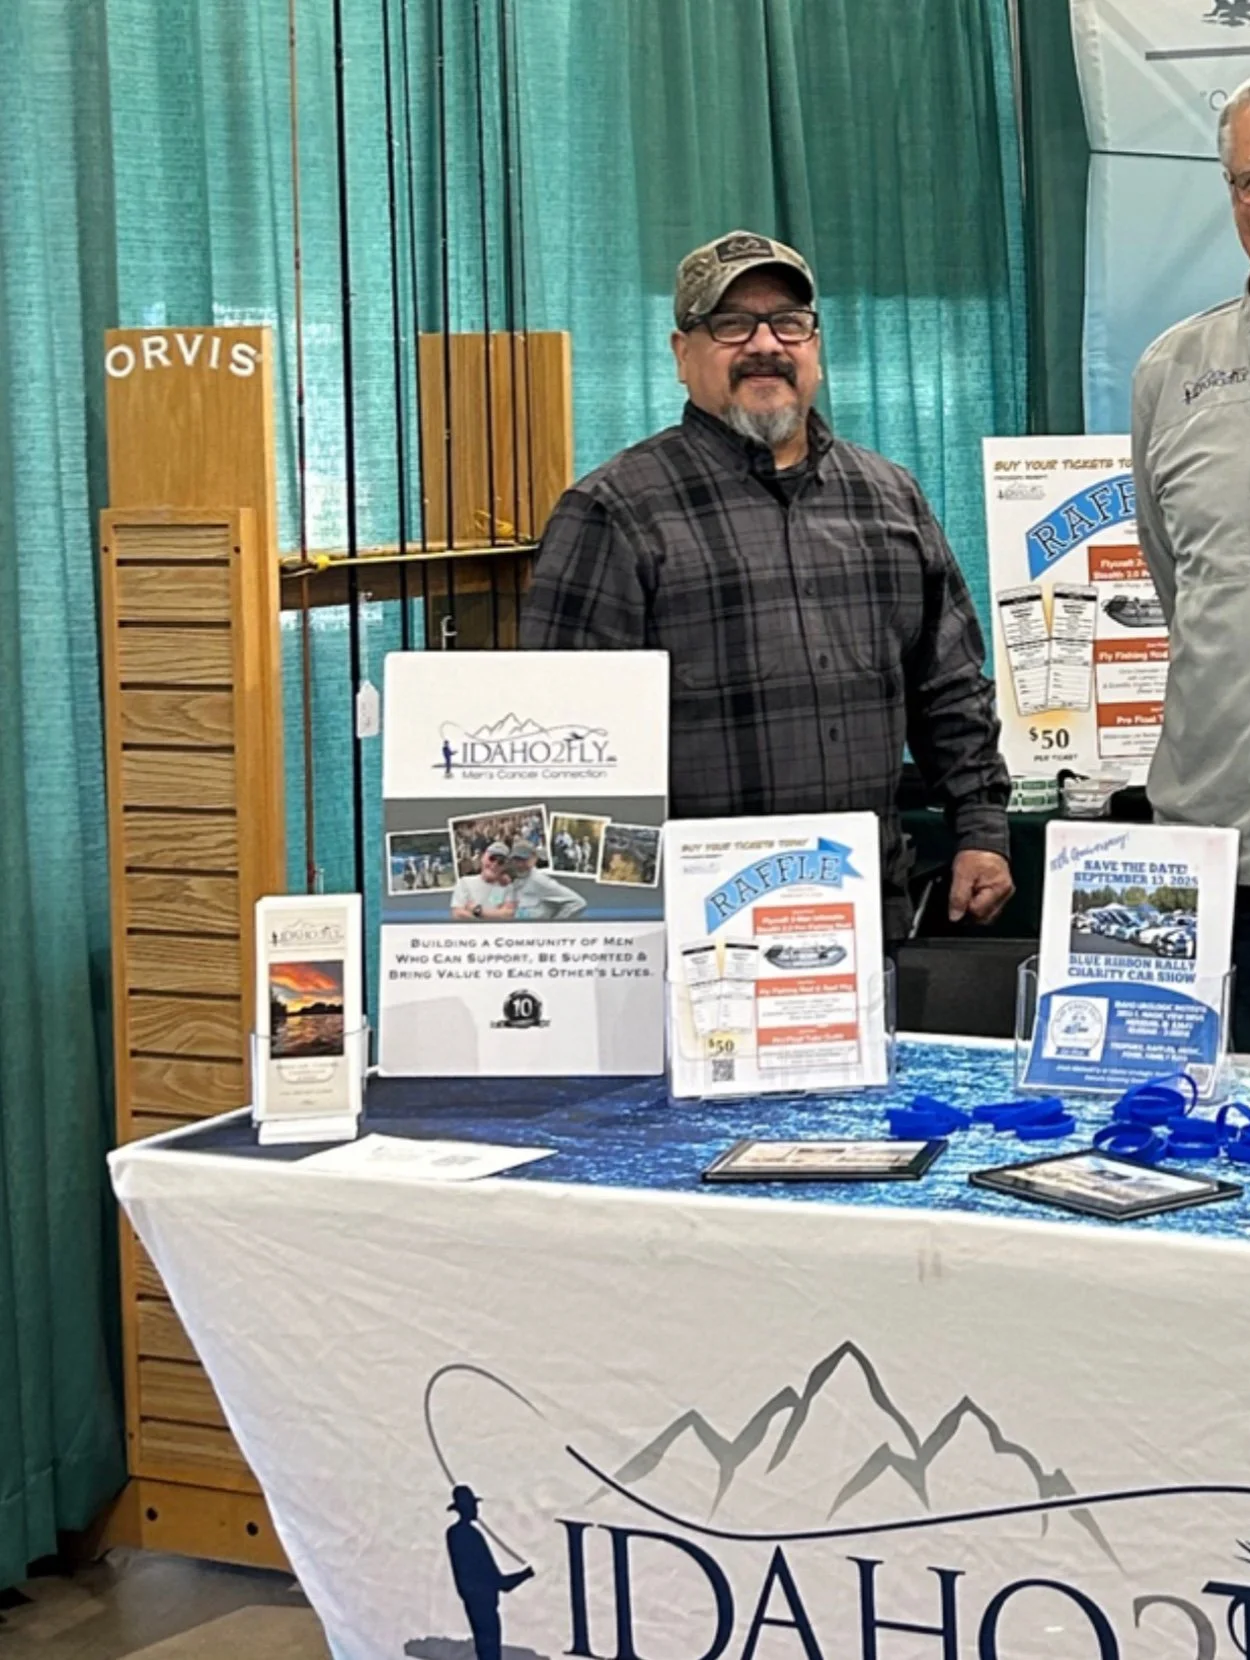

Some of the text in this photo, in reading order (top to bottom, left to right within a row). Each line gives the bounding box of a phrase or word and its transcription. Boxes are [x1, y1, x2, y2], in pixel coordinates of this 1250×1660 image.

[104, 333, 257, 377] ORVIS
[994, 460, 1022, 472] BUY
[1025, 459, 1058, 471] YOUR
[1062, 458, 1114, 471] TICKETS
[1027, 726, 1070, 750] $50
[461, 734, 609, 764] IDAHO2FLY
[496, 769, 539, 779] Cancer
[541, 769, 608, 779] Connection
[1084, 860, 1120, 872] SAVE
[1121, 861, 1146, 873] THE
[708, 854, 840, 918] RAFFLE
[1073, 871, 1148, 885] SEPTEMBER
[1069, 955, 1101, 966] BLUE
[1154, 959, 1195, 971] RALLY
[1067, 966, 1197, 983] CHARITY CAR SHOW
[512, 998, 533, 1017] 10
